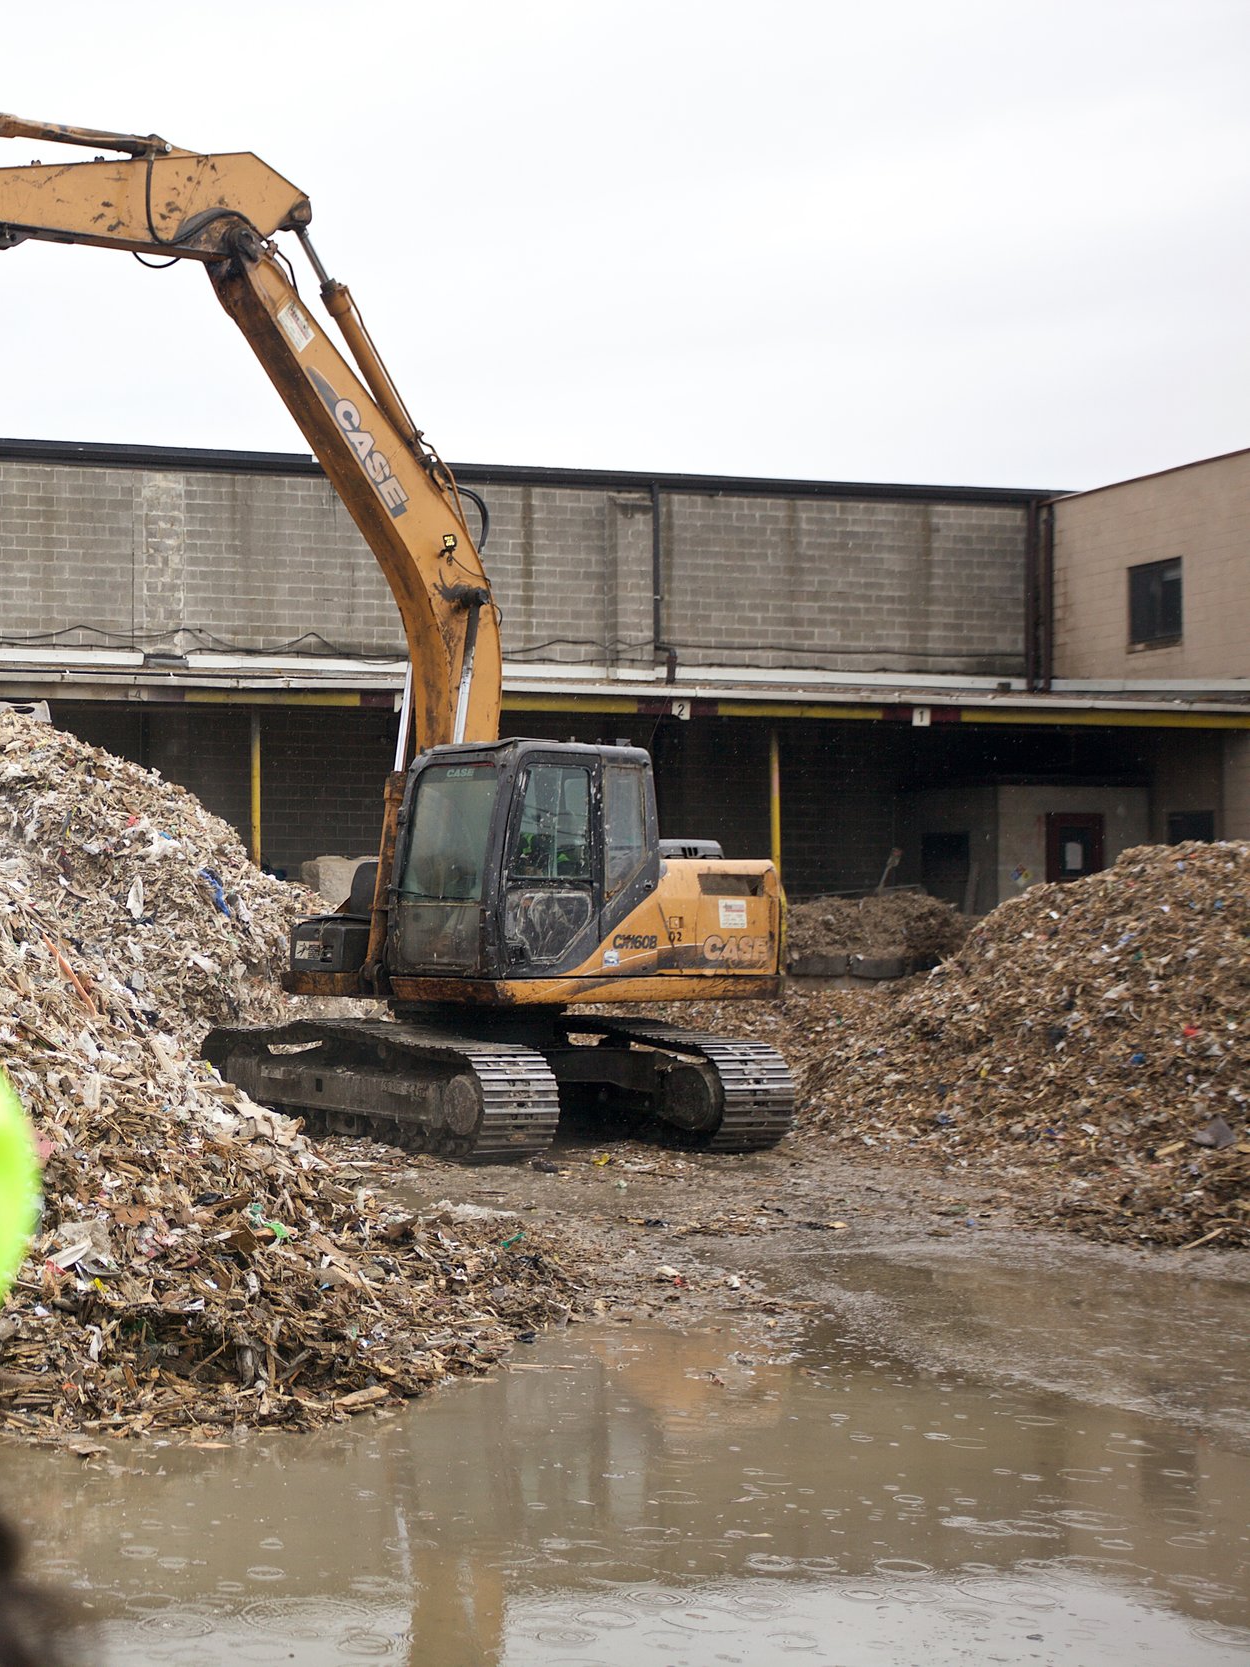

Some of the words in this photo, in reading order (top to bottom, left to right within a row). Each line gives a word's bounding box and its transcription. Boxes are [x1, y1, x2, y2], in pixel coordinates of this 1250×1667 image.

[334, 398, 409, 511] CASE
[678, 703, 685, 716] 2
[446, 767, 476, 778] CASE
[703, 935, 770, 961] CASE
